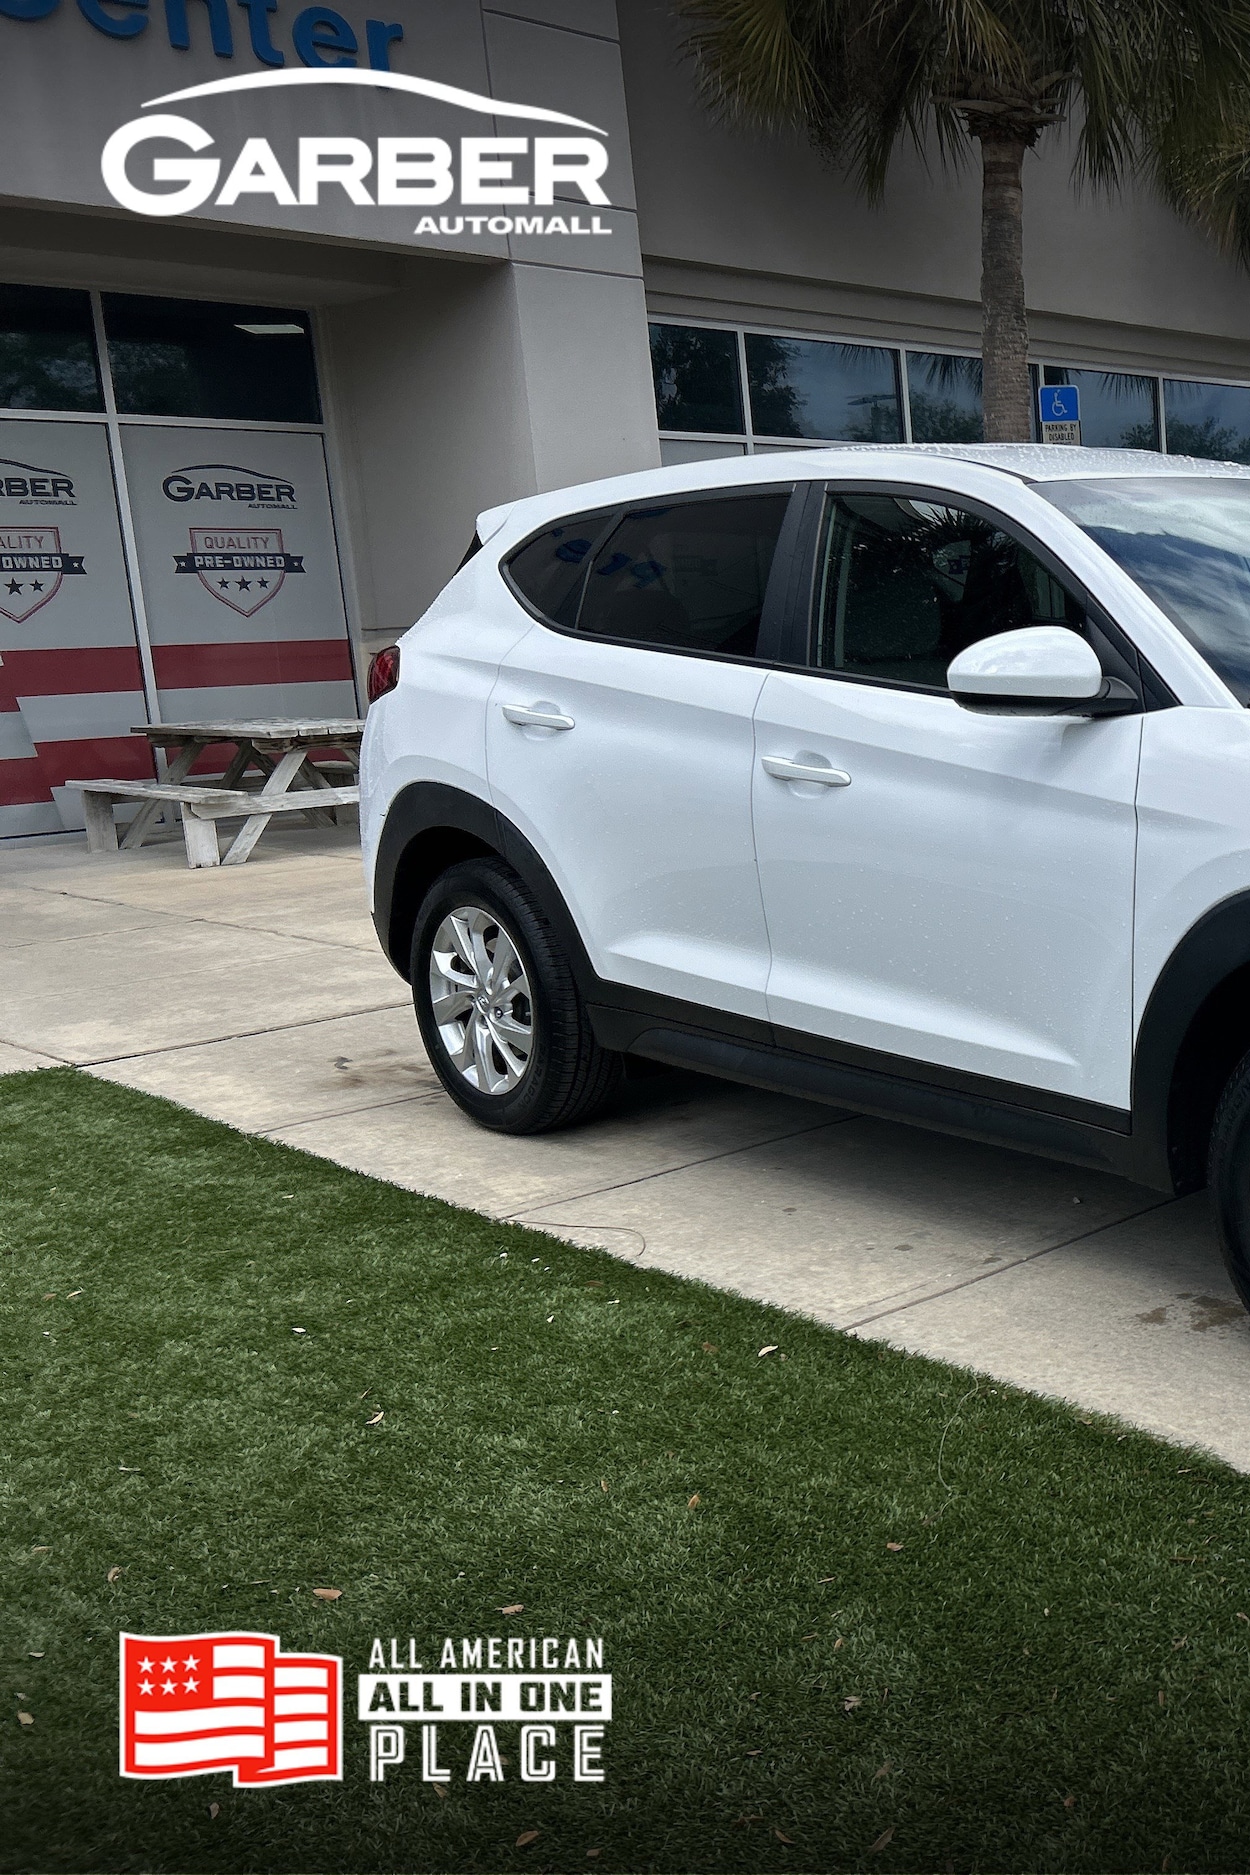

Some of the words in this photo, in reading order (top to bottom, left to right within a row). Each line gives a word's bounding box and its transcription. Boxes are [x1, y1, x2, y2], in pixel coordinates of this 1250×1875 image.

[162, 475, 297, 503] GARBER
[204, 536, 270, 550] QUALITY
[193, 555, 286, 569] PRE-OWNED
